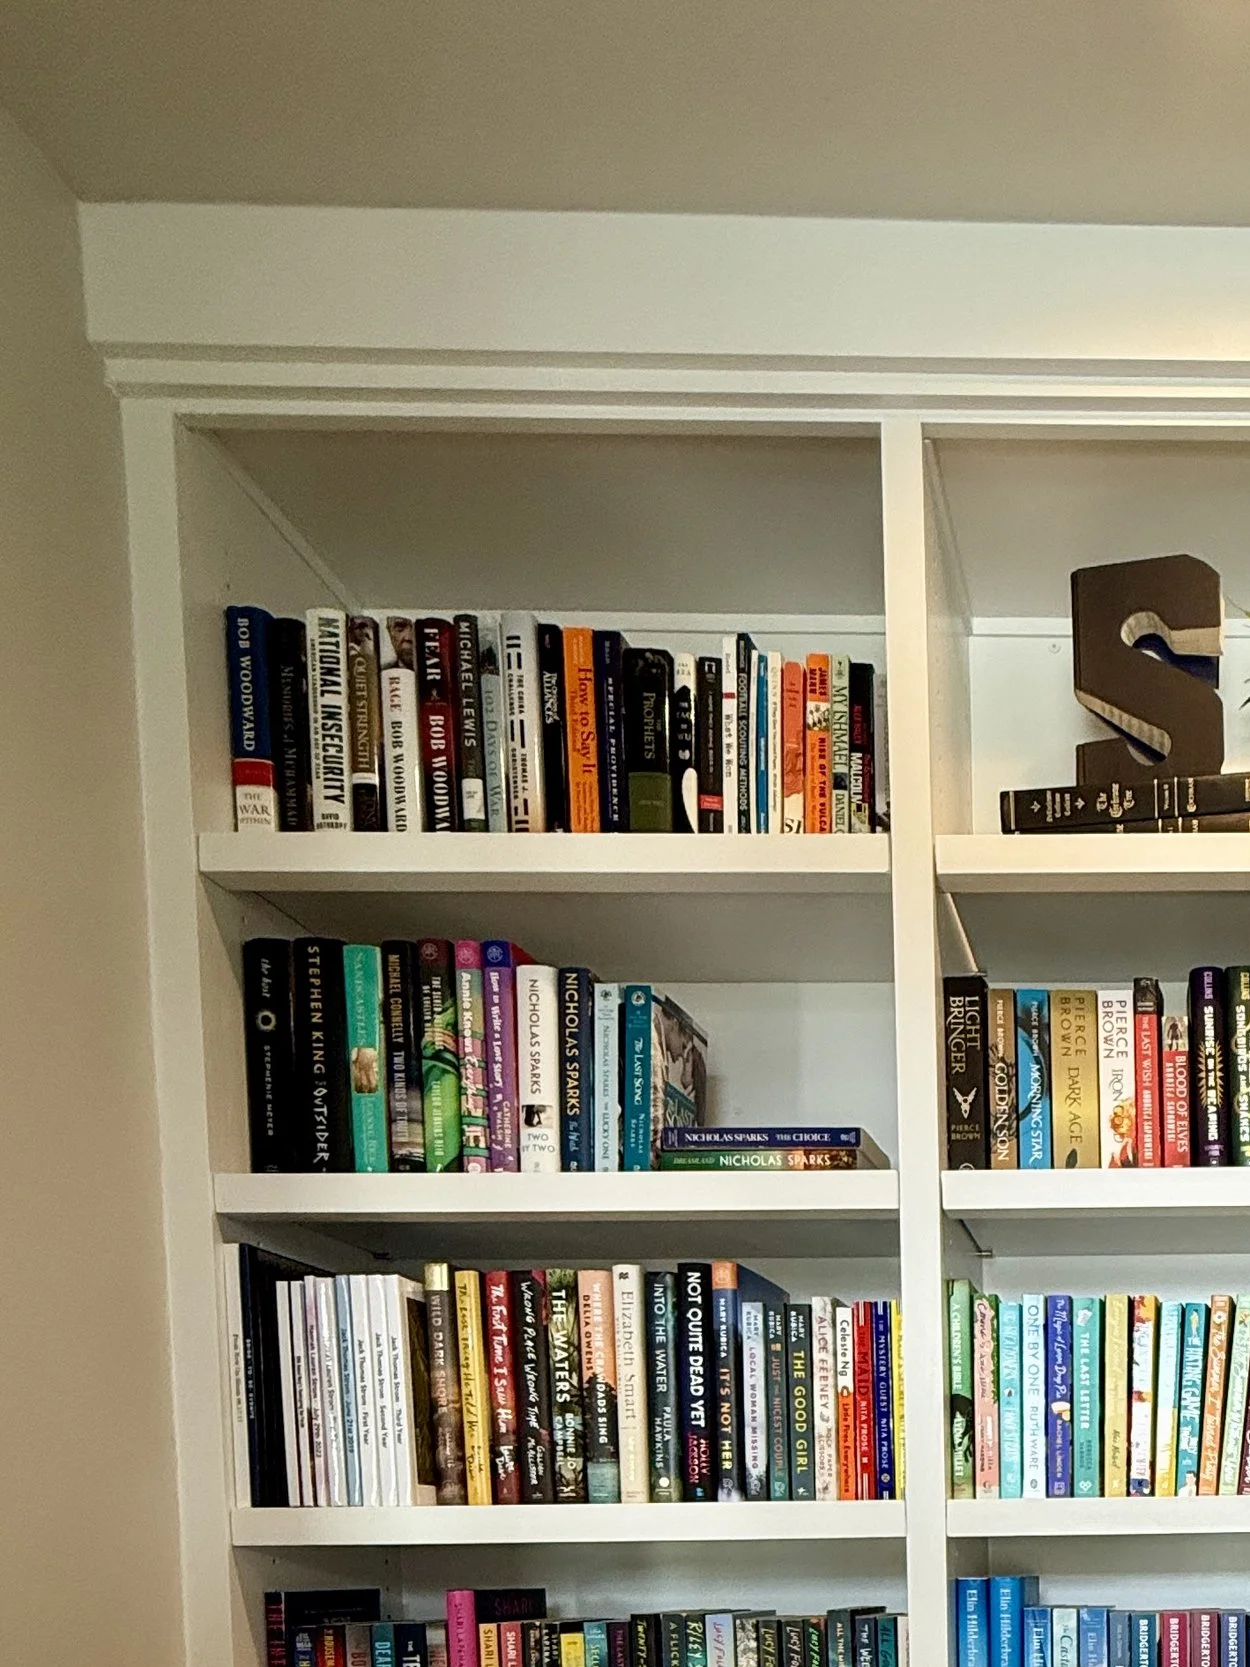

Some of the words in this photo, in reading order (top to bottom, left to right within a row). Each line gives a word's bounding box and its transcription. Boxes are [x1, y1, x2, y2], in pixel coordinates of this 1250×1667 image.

[238, 618, 250, 648] BOB
[319, 617, 342, 697] NATIONAL
[424, 628, 441, 680] FEAR
[459, 621, 472, 689] MICHAEL
[353, 658, 366, 695] QUIET
[389, 677, 401, 712] RAGE
[578, 668, 592, 705] How
[738, 673, 747, 716] FOOTBALL
[240, 655, 255, 751] WOODWARD
[833, 686, 846, 708] MY
[356, 695, 370, 769] STRENGTH
[391, 721, 404, 748] BOB
[463, 699, 476, 747] LEWIS
[580, 712, 591, 726] to
[643, 692, 655, 759] PROPHETS
[321, 705, 344, 803] INSECURITY
[486, 721, 497, 756] DAYS
[580, 731, 595, 760] Say
[739, 720, 747, 765] SCOUTING
[834, 710, 847, 769] ISHMAEL
[489, 761, 499, 776] OF
[583, 763, 596, 774] It
[393, 754, 407, 832] WOODWARD
[490, 785, 500, 817] WAR
[307, 946, 321, 1023] STEPHEN
[388, 954, 399, 993] MICHAEL
[460, 972, 473, 1009] Annie
[391, 998, 404, 1044] CONNELLY
[528, 979, 540, 1047] NICHOLAS
[565, 973, 579, 1057] NICHOLAS
[965, 997, 979, 1050] LIGHT
[1102, 1001, 1114, 1059] BROWN
[1115, 1001, 1128, 1058] PIERCE
[462, 1012, 474, 1053] Knows
[947, 996, 965, 1074] BRINGER
[312, 1032, 325, 1074] KING
[634, 1054, 643, 1077] LAST
[530, 1051, 541, 1094] SPARKS
[566, 1062, 580, 1115] SPARKS
[634, 1078, 643, 1105] SONG
[1066, 1067, 1080, 1107] DARK
[1175, 1056, 1186, 1096] BLOOD
[994, 1063, 1008, 1123] GOLDEN
[1029, 1063, 1042, 1128] MORNING
[1176, 1101, 1187, 1117] OF
[997, 1130, 1008, 1160] SON
[1069, 1112, 1082, 1144] AGE
[1177, 1121, 1187, 1152] ELVES
[719, 1156, 782, 1166] NICHOLAS
[788, 1155, 830, 1165] SPARKS
[1030, 1132, 1042, 1164] STAR
[521, 1282, 532, 1323] WRONG
[552, 1289, 566, 1323] THE
[687, 1272, 701, 1304] NOT
[687, 1308, 702, 1352] QUITE
[839, 1320, 849, 1358] Celeste
[1028, 1305, 1039, 1337] ONE
[523, 1327, 536, 1359] PLACE
[1028, 1343, 1039, 1359] BY
[524, 1363, 538, 1402] WRONG
[554, 1330, 569, 1402] WATERS
[690, 1356, 703, 1396] DEAD
[794, 1351, 805, 1378] THE
[839, 1361, 849, 1376] Ng
[1028, 1364, 1039, 1395] ONE
[527, 1406, 539, 1429] TIME
[691, 1400, 704, 1428] YET
[795, 1386, 806, 1432] GOOD
[796, 1440, 808, 1474] GIRL
[1000, 1589, 1010, 1610] Elin
[483, 1629, 493, 1660] SHARI
